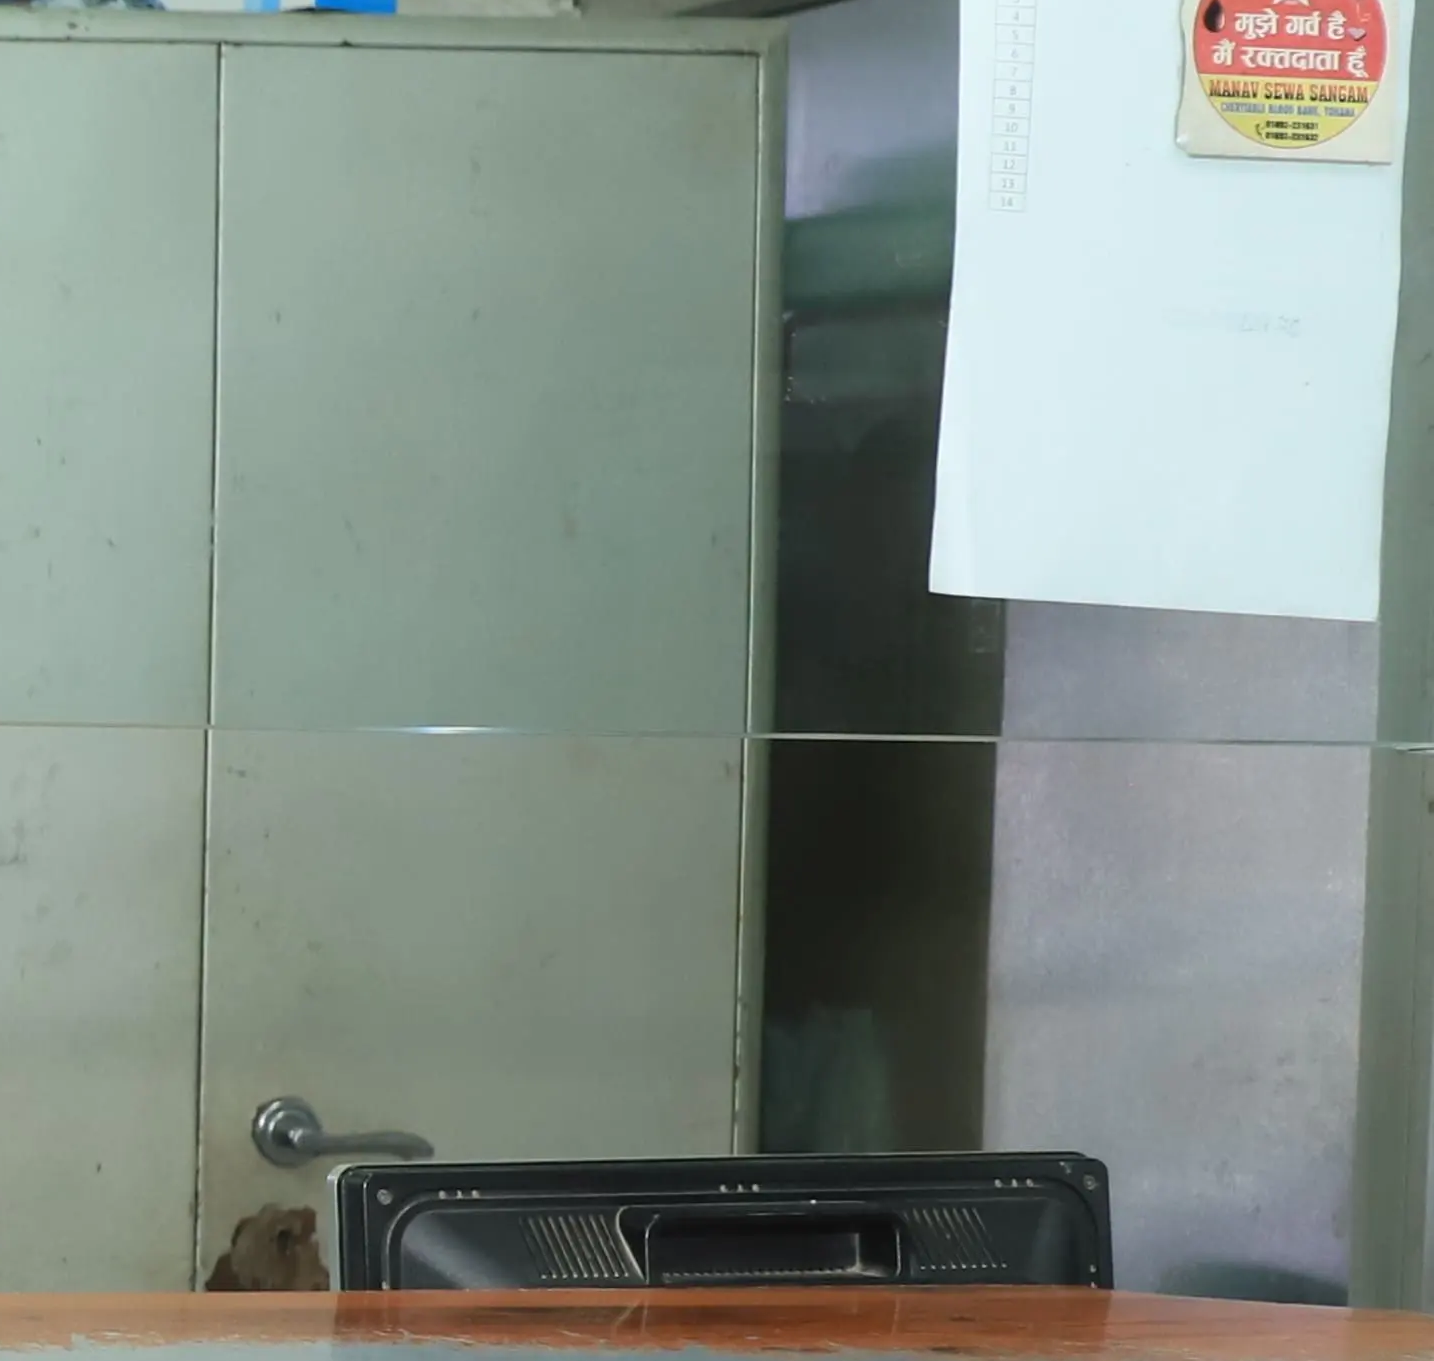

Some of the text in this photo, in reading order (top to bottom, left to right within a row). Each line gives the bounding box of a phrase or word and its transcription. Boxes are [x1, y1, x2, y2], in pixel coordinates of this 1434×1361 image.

[1234, 8, 1348, 39] मुझे गर्व है
[1212, 38, 1369, 77] मैं रक्तदाता हूँ
[1208, 79, 1370, 103] MANAV SEWA SANGAM
[1005, 122, 1018, 132] 10
[1004, 141, 1016, 151] 11
[1003, 160, 1015, 169] 12
[1002, 178, 1014, 188] 13
[1001, 197, 1013, 207] 14
